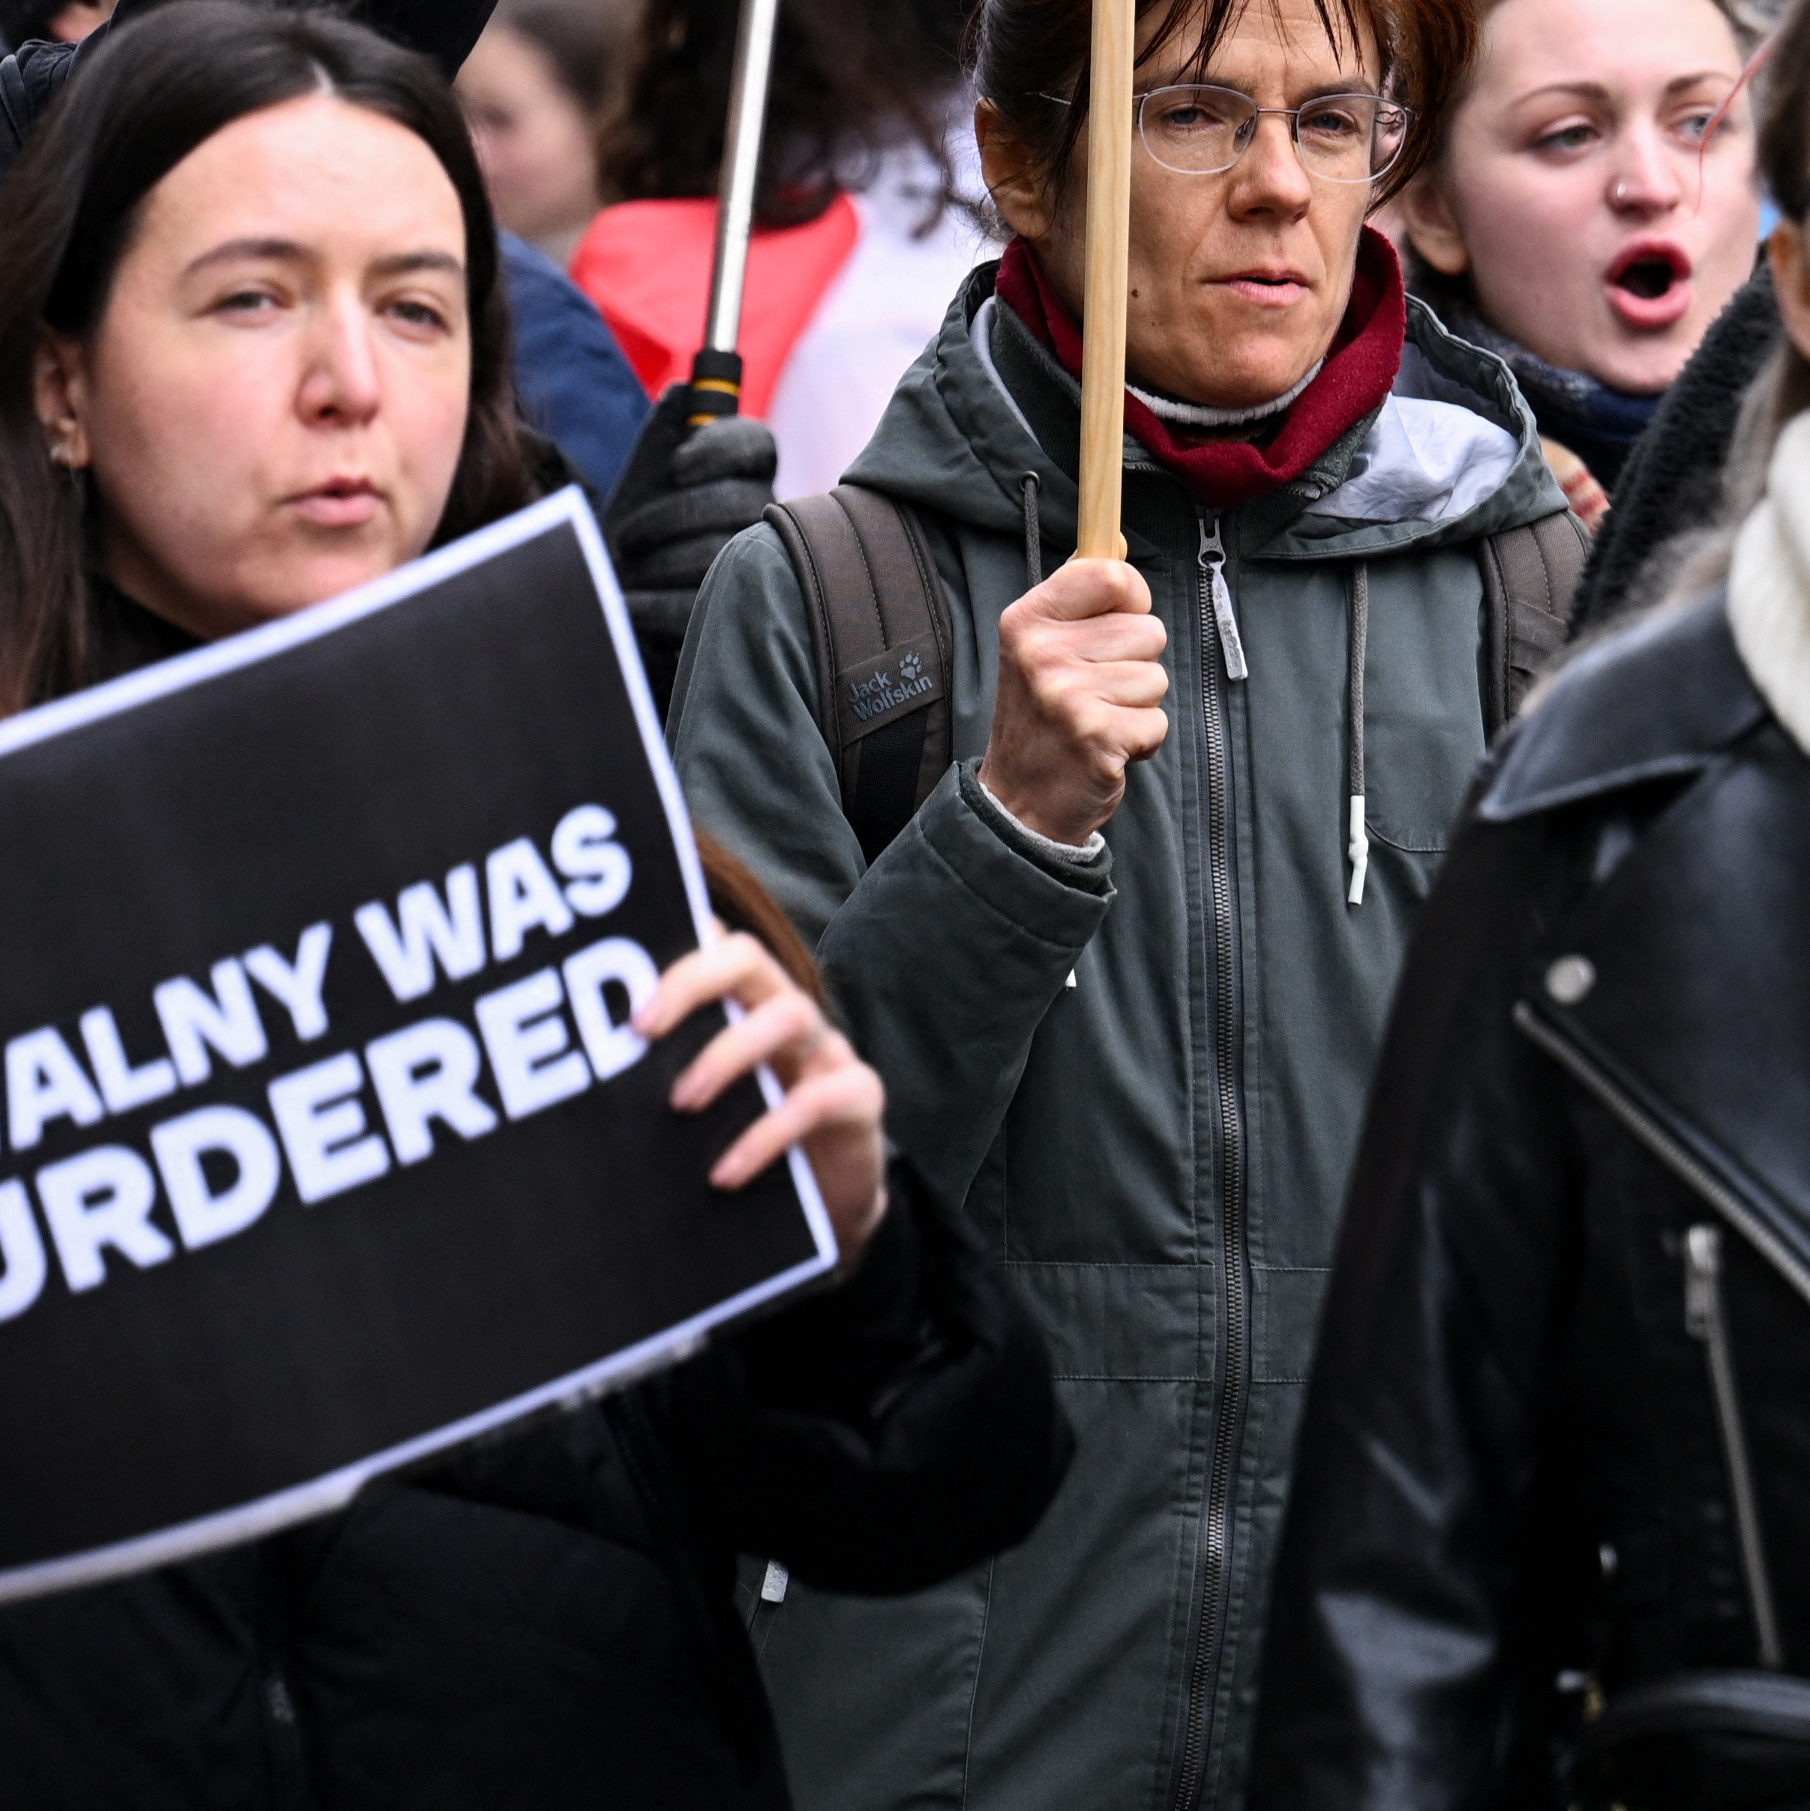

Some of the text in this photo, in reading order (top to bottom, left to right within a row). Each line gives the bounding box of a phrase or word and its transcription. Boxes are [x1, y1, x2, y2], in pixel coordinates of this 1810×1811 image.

[849, 671, 892, 704] Jack
[852, 674, 933, 722] Wolfskin
[354, 805, 632, 1001] WAS
